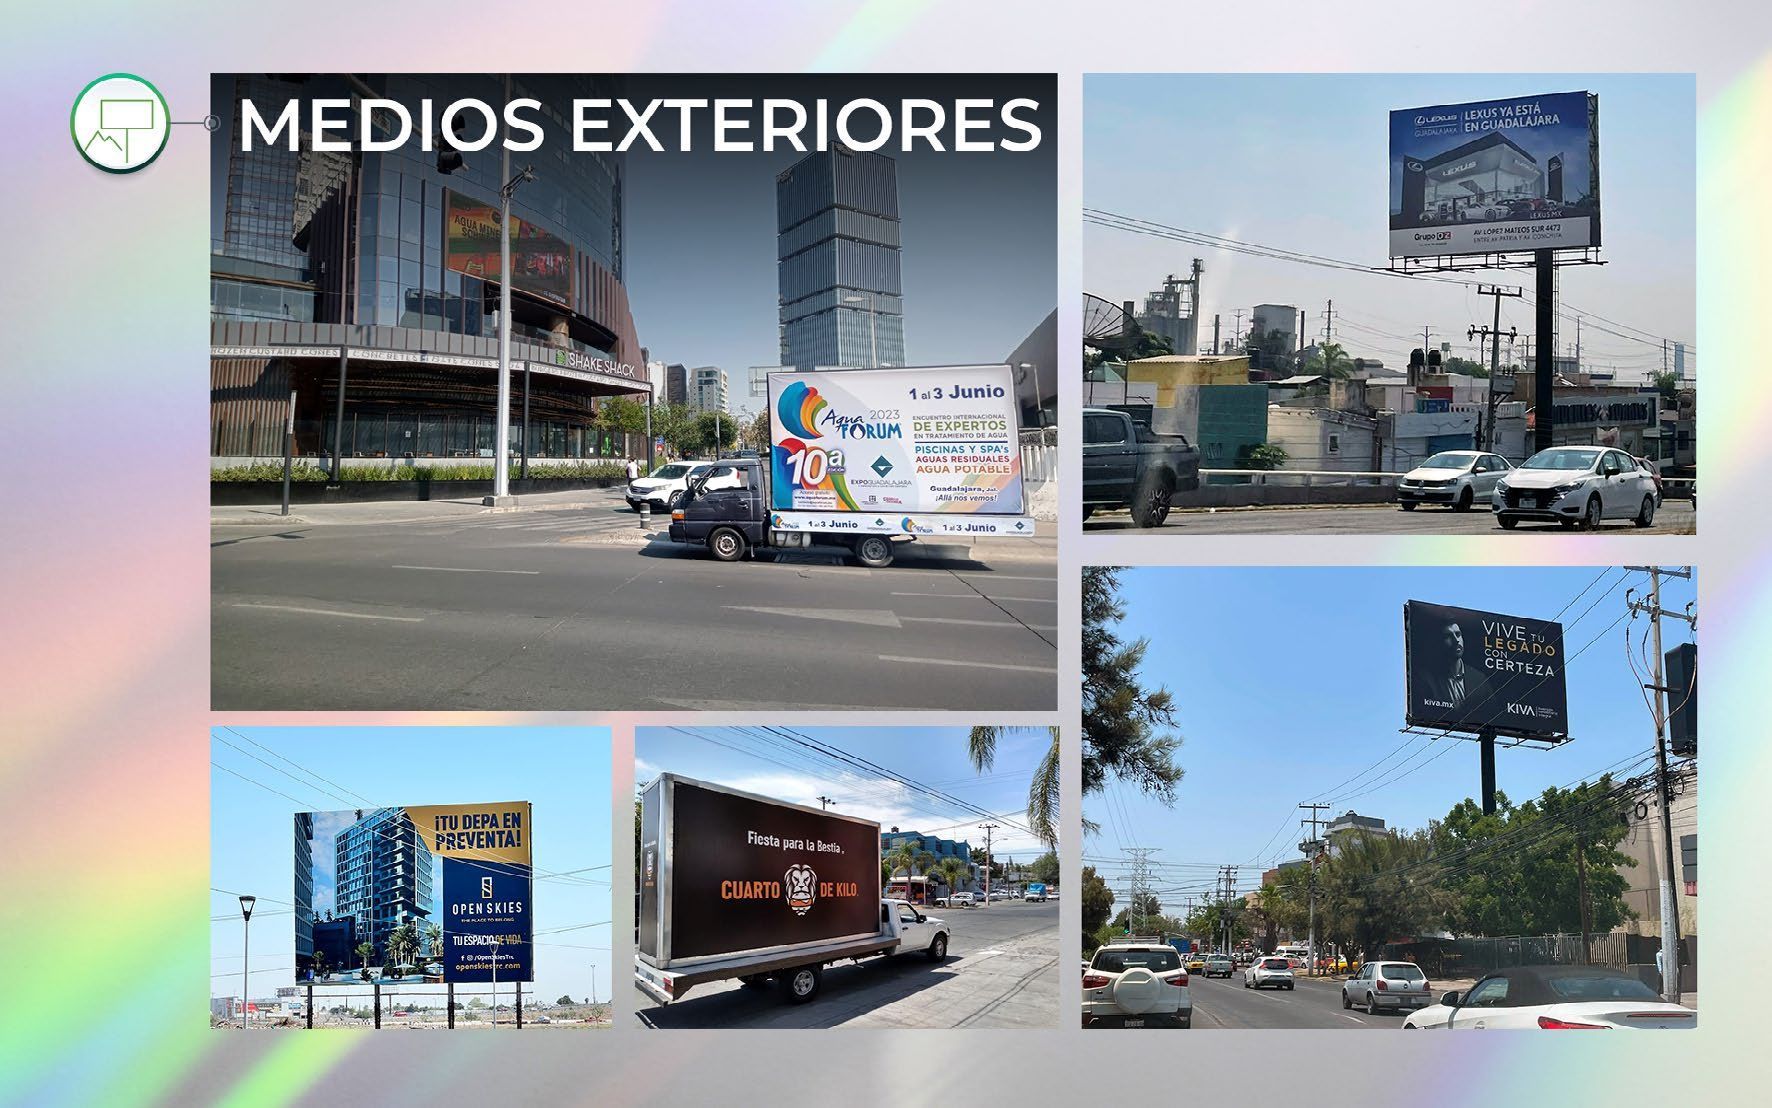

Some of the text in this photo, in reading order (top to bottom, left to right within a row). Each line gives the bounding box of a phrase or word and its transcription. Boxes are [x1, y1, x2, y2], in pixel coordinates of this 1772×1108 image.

[1465, 101, 1542, 121] LEXUS YA ESTÁ
[1425, 114, 1458, 123] LEXUS
[1465, 114, 1560, 132] EN GUADALAJARA
[1415, 128, 1457, 138] GUADALAJARA
[1442, 161, 1477, 176] LEXUS
[454, 214, 478, 231] AGUA
[1504, 226, 1531, 234] MATEOS
[1531, 225, 1545, 233] SUR
[1545, 224, 1561, 232] 4473
[1414, 232, 1436, 241] Grupo
[569, 352, 603, 373] SHAKE
[604, 360, 636, 378] SHACK
[909, 384, 1005, 400] 1 al 3 Junio
[869, 409, 900, 421] 2023
[841, 422, 903, 440] FORUM
[914, 420, 1007, 432] DE EXPERTOS
[988, 431, 1009, 439] AGUA
[915, 445, 1009, 454] PISCINAS Y SPA's
[915, 455, 1010, 463] AGUAS RESIDUALES
[916, 464, 1011, 474] AGUA POTABLE
[930, 485, 985, 493] Guadalajara,
[936, 493, 953, 502] ¡Allá
[969, 493, 998, 502] vemos!
[829, 520, 859, 529] Junio
[965, 523, 997, 532] Junio
[1482, 619, 1545, 643] VIVE TU
[1484, 636, 1556, 657] LEGADO
[1484, 648, 1508, 659] CON
[1485, 657, 1555, 677] CERTEZA
[1424, 698, 1455, 709] kiva.mx
[1507, 702, 1536, 717] KIVA
[435, 812, 521, 831] ¡TU DEPA EN
[436, 830, 521, 850] PREVENTA!
[747, 830, 780, 848] Fiesta
[783, 839, 804, 851] para
[806, 839, 815, 851] la
[721, 880, 780, 900] CUARTO
[820, 882, 834, 897] DE
[452, 901, 522, 915] OPEN SKIES
[453, 935, 463, 945] TU
[464, 935, 495, 945] ESPACIO
[505, 934, 522, 945] VIDA
